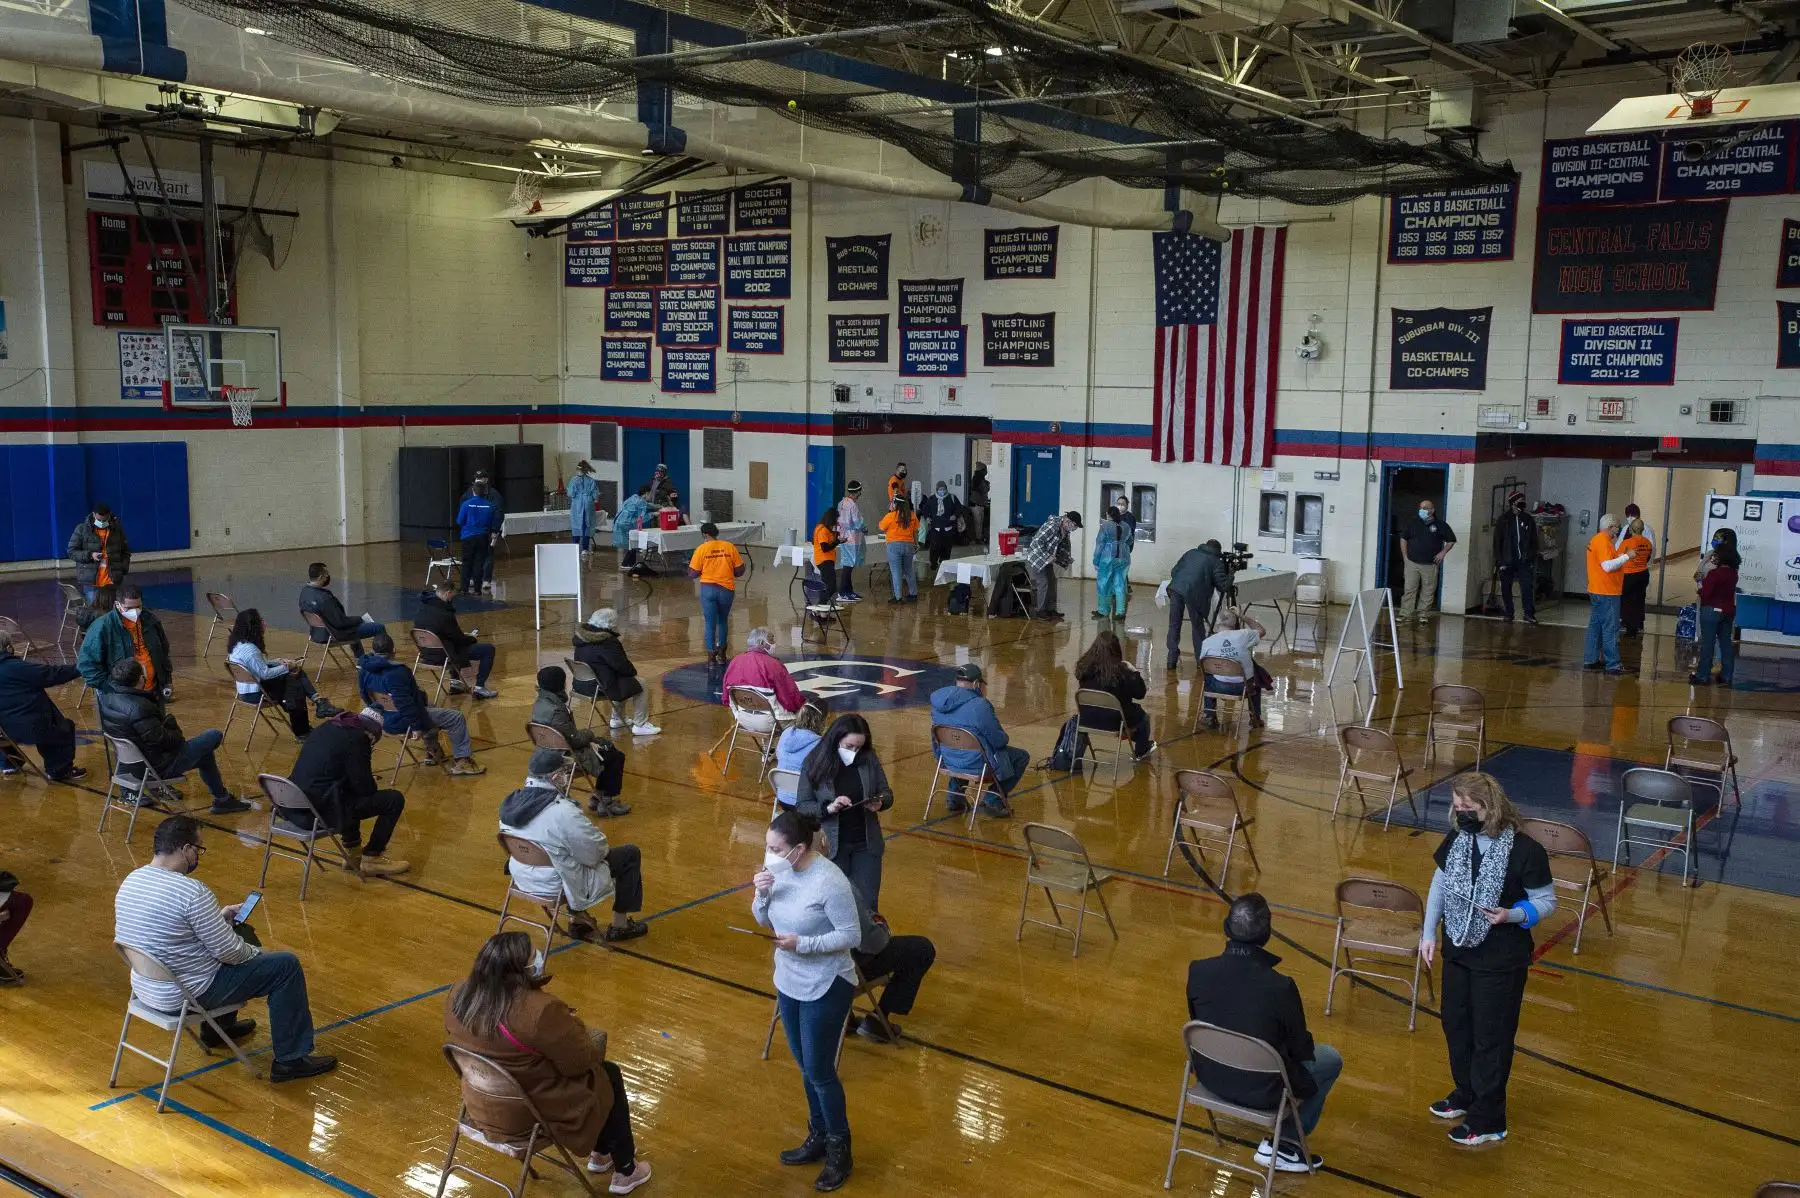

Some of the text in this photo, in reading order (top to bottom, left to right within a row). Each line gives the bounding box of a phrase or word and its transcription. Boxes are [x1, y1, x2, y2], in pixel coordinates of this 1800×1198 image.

[1553, 140, 1651, 157] BOYS BASKETBALL
[1552, 156, 1650, 172] DIVISION III-CENTRAL
[1677, 161, 1775, 177] CHAMPIONS
[1555, 172, 1644, 187] CHAMPIONS
[745, 188, 782, 198] SOCCER
[1582, 189, 1614, 199] 2018
[702, 204, 723, 212] SOCCER
[1401, 197, 1506, 214] CLASS B BASKETBALL
[740, 208, 786, 218] CHAMPIONS
[102, 216, 126, 229] Home
[1405, 214, 1500, 228] CHAMPIONS
[994, 233, 1048, 243] WRESTLING
[1399, 230, 1504, 243] 1953 1954 1955 1957
[1548, 220, 1712, 256] CENTRAL FALLS
[617, 246, 634, 254] BOYS
[740, 242, 755, 251] STATE
[758, 241, 787, 250] CHAMPIONS
[990, 245, 1026, 253] SUBURBAN
[1397, 244, 1501, 256] 1958 1959 1960 1961
[992, 255, 1049, 265] CHAMPIONS
[617, 264, 663, 272] CHAMPIONS
[670, 263, 716, 271] CO-CHAMPIONS
[838, 266, 878, 274] WRESTLING
[731, 269, 786, 279] BOYS SOCCER
[1560, 262, 1690, 293] HIGH SCHOOL
[745, 283, 770, 292] 2002
[838, 282, 878, 291] CO-CHAMPS
[938, 284, 958, 292] NORTH
[610, 292, 624, 300] BOYS
[660, 290, 714, 298] RHODE ISLAND
[908, 294, 953, 303] WRESTLING
[660, 300, 715, 310] STATE CHAMPIONS
[903, 306, 956, 314] CHAMPIONS
[667, 312, 708, 320] DIVISION III
[733, 311, 778, 319] BOYS SOCCER
[662, 322, 713, 331] BOYS SOCCER
[992, 319, 1045, 328] WRESTLING
[837, 328, 878, 336] WRESTLING
[907, 330, 959, 339] WRESTLING
[1398, 322, 1480, 345] SUBURBAN DIV. III
[1574, 325, 1664, 336] UNIFIED BASKETBALL
[675, 333, 700, 342] 2005
[733, 332, 777, 340] CHAMPIONS
[837, 339, 879, 347] CO-CHAMPIONS
[910, 342, 939, 351] DIVISION
[987, 342, 1050, 350] CHAMPIONS
[1584, 340, 1651, 350] DIVISION II
[906, 353, 958, 361] CHAMPIONS
[1402, 352, 1476, 362] BASKETBALL
[1571, 354, 1663, 365] STATE CHAMPIONS
[692, 362, 708, 370] NORTH
[917, 364, 948, 372] 2009-10
[668, 372, 709, 380] CHAMPIONS
[1407, 368, 1469, 377] CO-CHAMPS
[1591, 370, 1639, 378] 2011-12
[1602, 403, 1619, 415] EXIT
